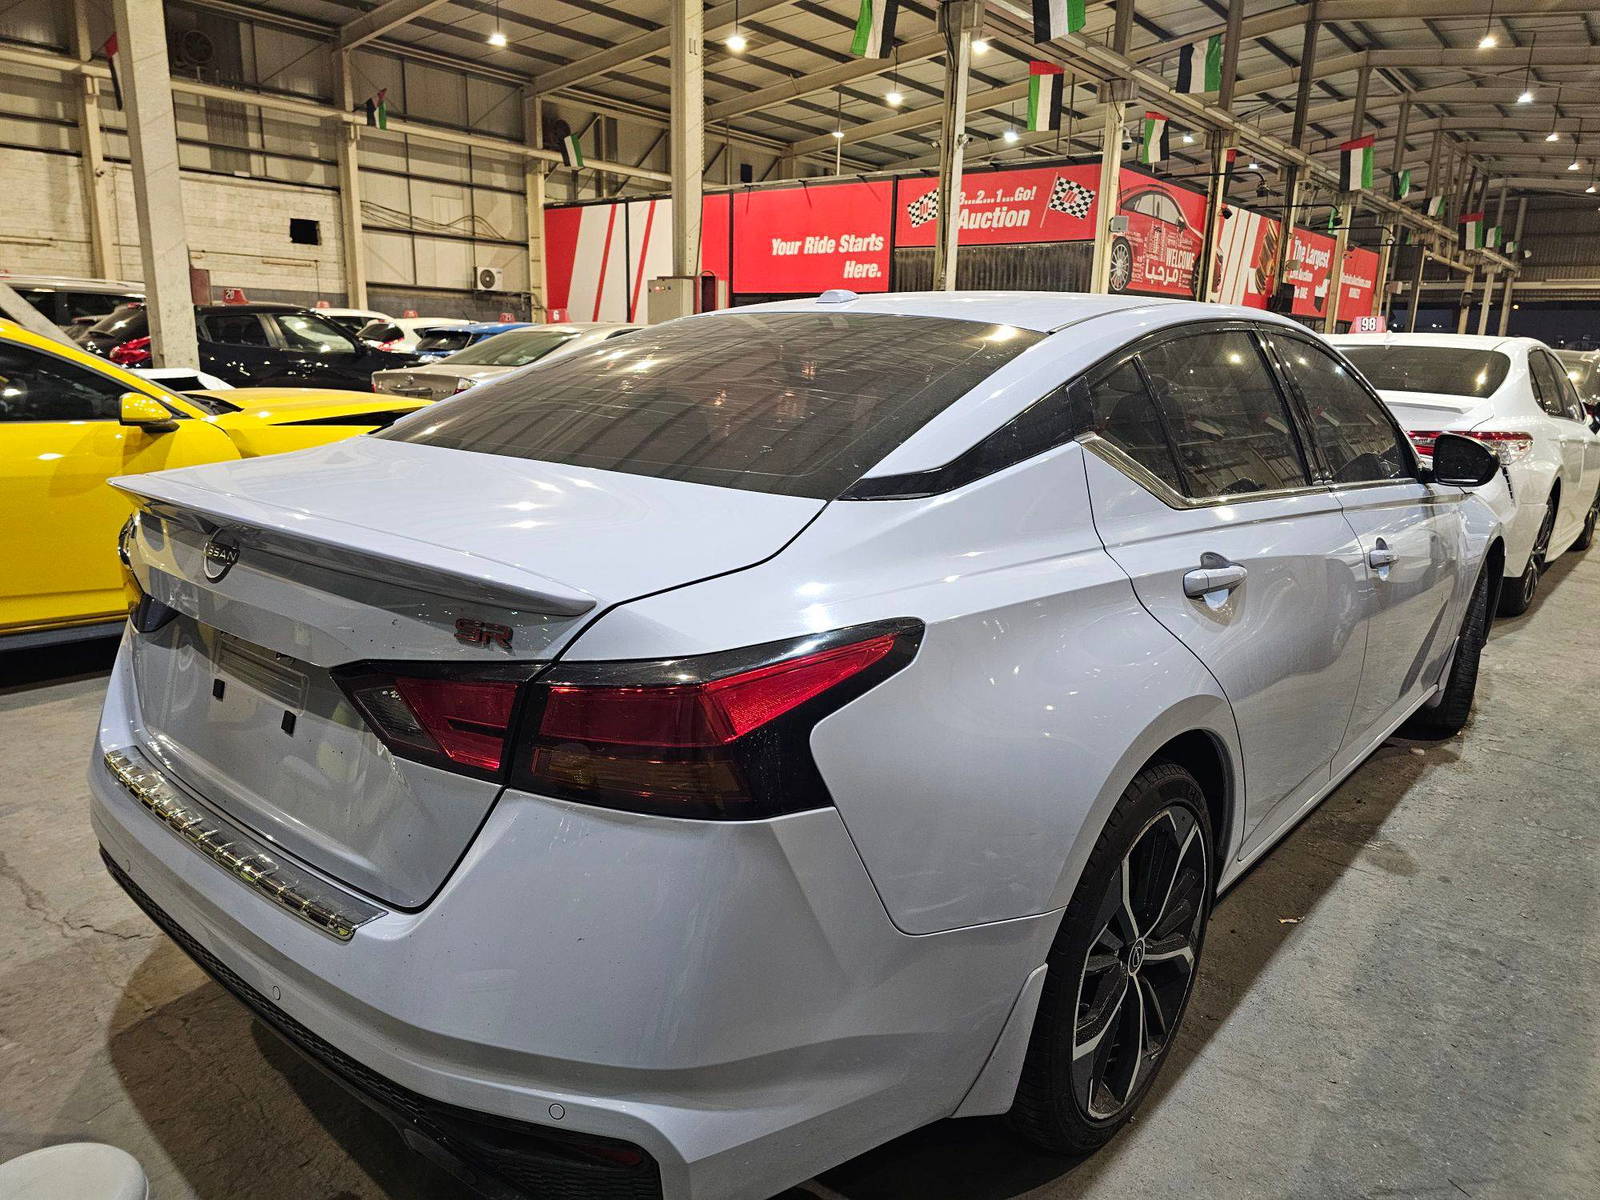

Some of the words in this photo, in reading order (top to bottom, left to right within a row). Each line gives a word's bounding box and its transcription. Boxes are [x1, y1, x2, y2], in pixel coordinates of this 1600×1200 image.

[958, 206, 1031, 230] Auction
[771, 238, 801, 257] Your
[803, 235, 837, 255] Ride
[838, 233, 884, 253] Starts
[1293, 237, 1306, 263] The
[1305, 243, 1330, 270] Largest
[843, 261, 882, 279] Here.
[1166, 247, 1195, 271] WELCOME
[1145, 259, 1179, 286] مرحبا
[1361, 317, 1377, 331] 98
[455, 618, 514, 651] SR
